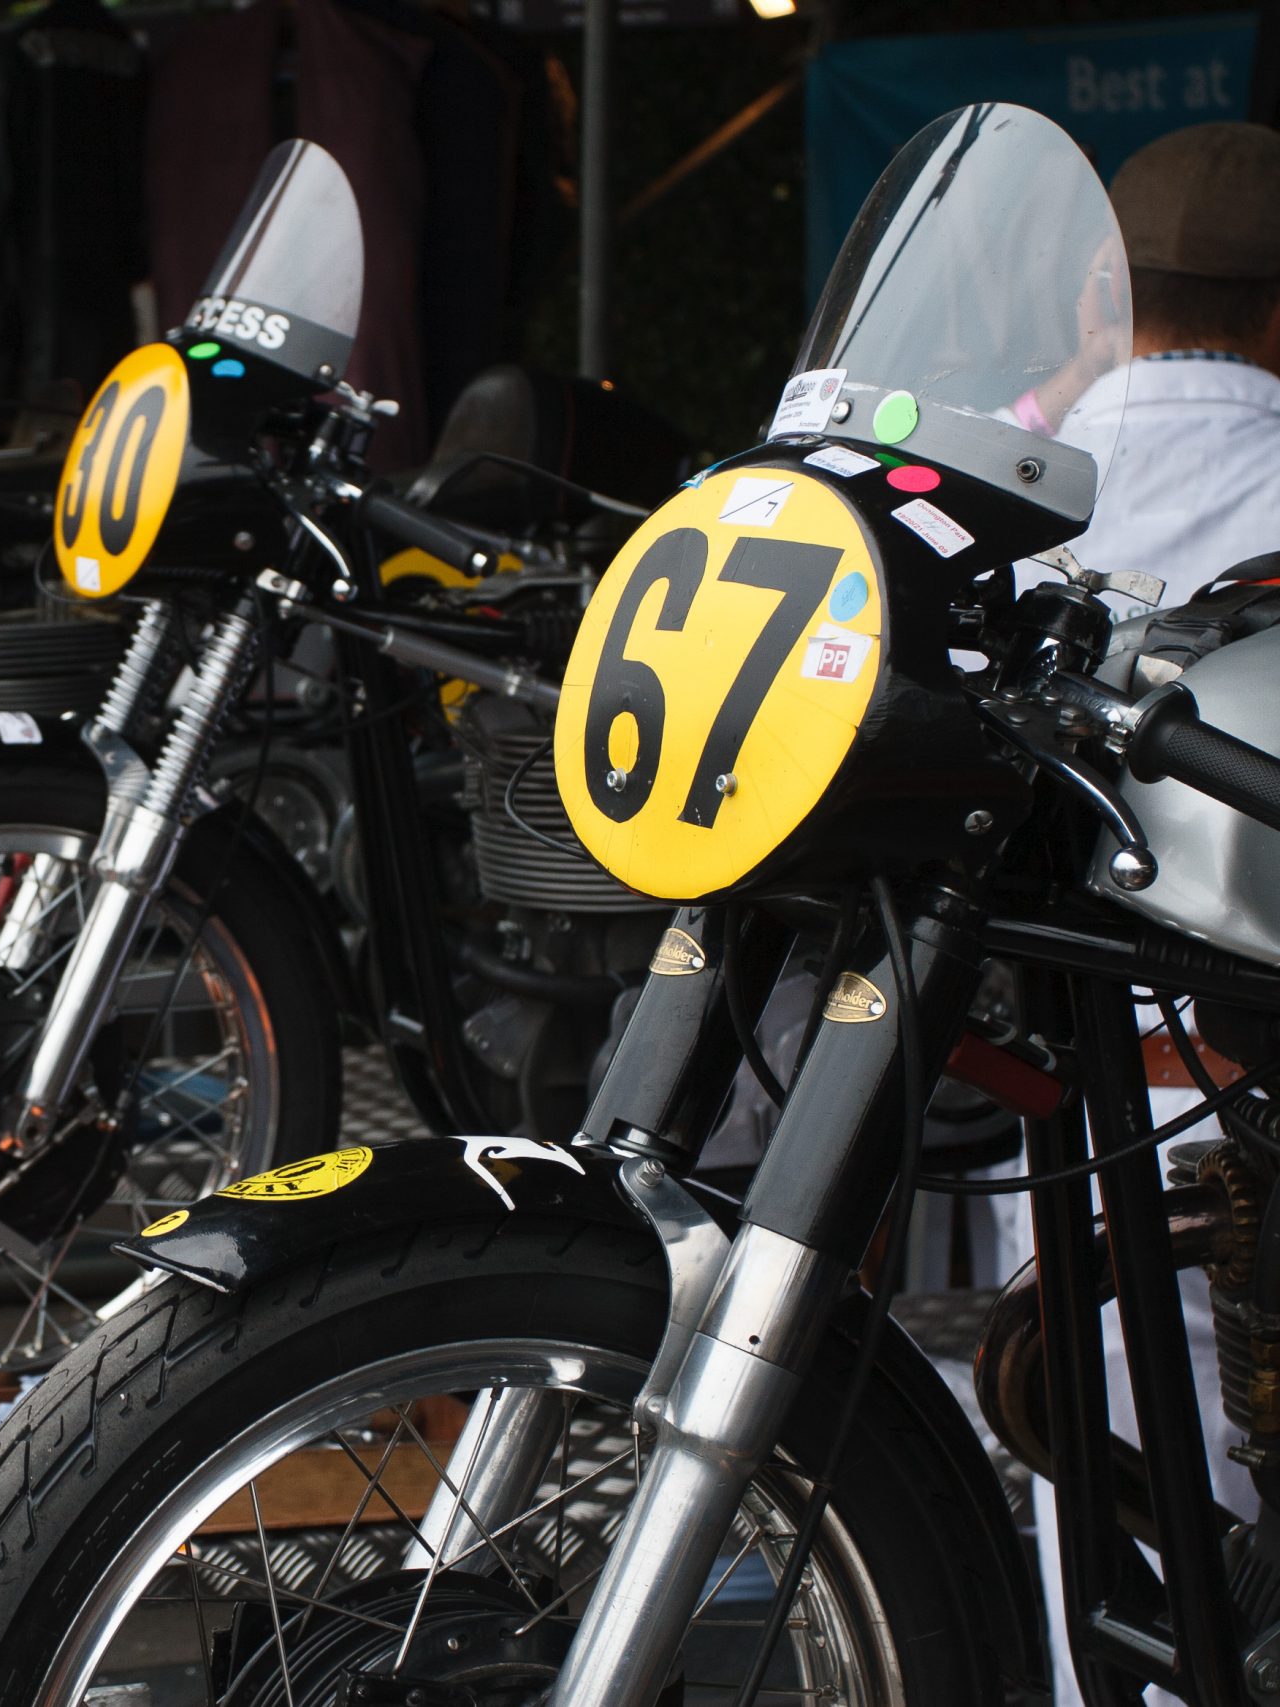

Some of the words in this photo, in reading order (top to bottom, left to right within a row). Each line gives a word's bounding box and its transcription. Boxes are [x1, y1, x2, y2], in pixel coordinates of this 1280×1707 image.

[1068, 56, 1166, 112] Best
[1184, 58, 1231, 109] at
[62, 380, 166, 556] 30
[923, 530, 939, 546] June
[950, 527, 967, 542] Park
[584, 527, 845, 829] 67
[819, 648, 848, 673] PP
